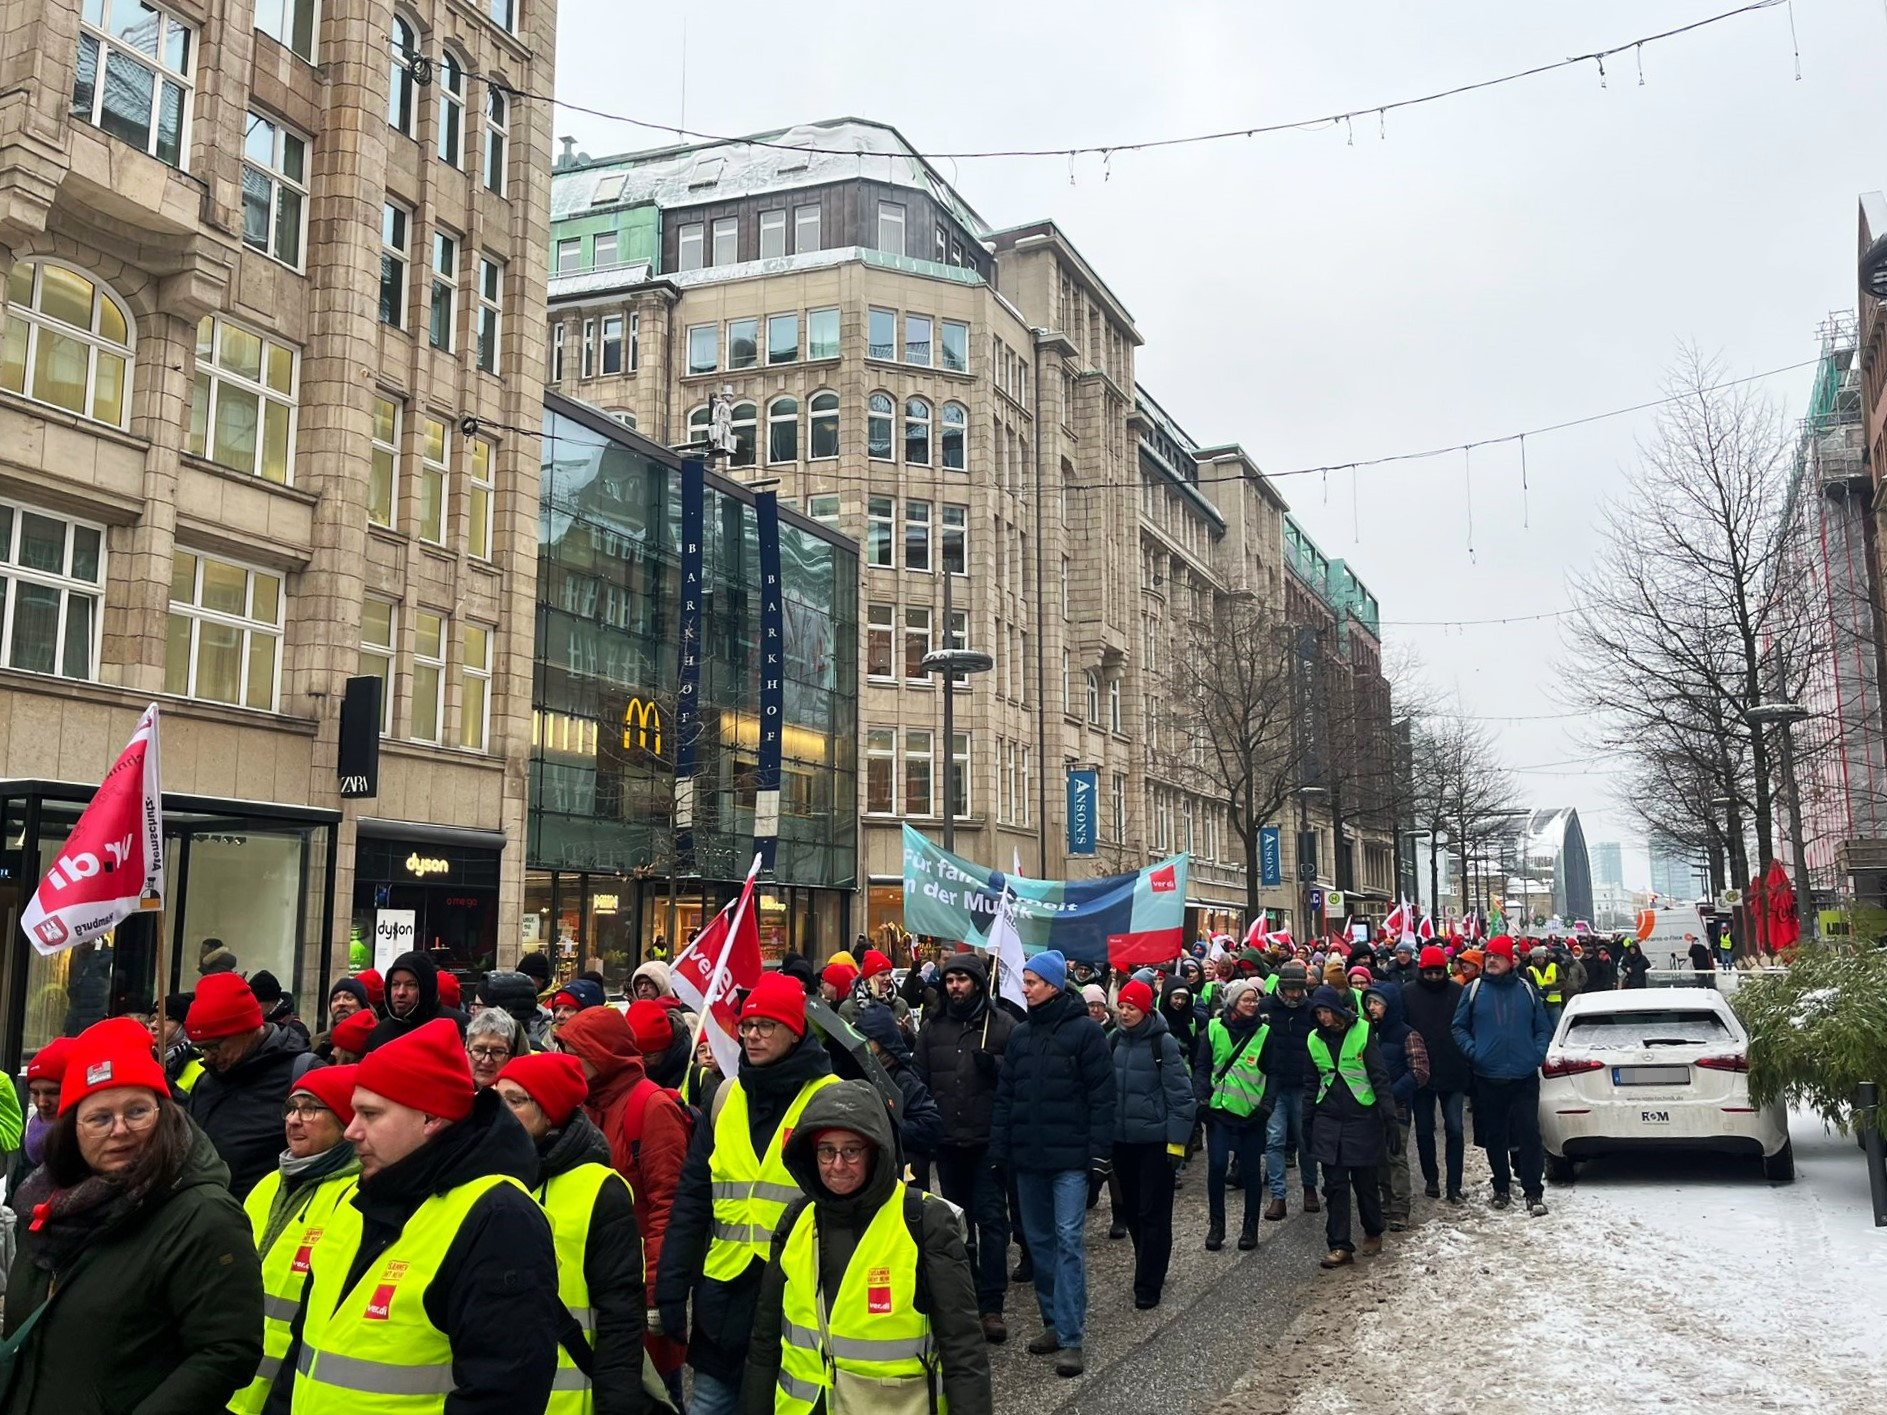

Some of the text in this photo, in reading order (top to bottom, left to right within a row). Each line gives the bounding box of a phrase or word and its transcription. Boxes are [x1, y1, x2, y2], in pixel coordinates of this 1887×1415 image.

[681, 543, 697, 723] BARKHOF
[766, 574, 779, 741] BARKHOF
[340, 775, 368, 793] ZARA
[1074, 778, 1091, 845] ANSON'S
[406, 852, 449, 877] dyson
[903, 848, 932, 874] Für
[923, 880, 958, 907] der
[963, 890, 1034, 920] Muik
[377, 919, 413, 940] dyson
[367, 1303, 388, 1316] ver.di
